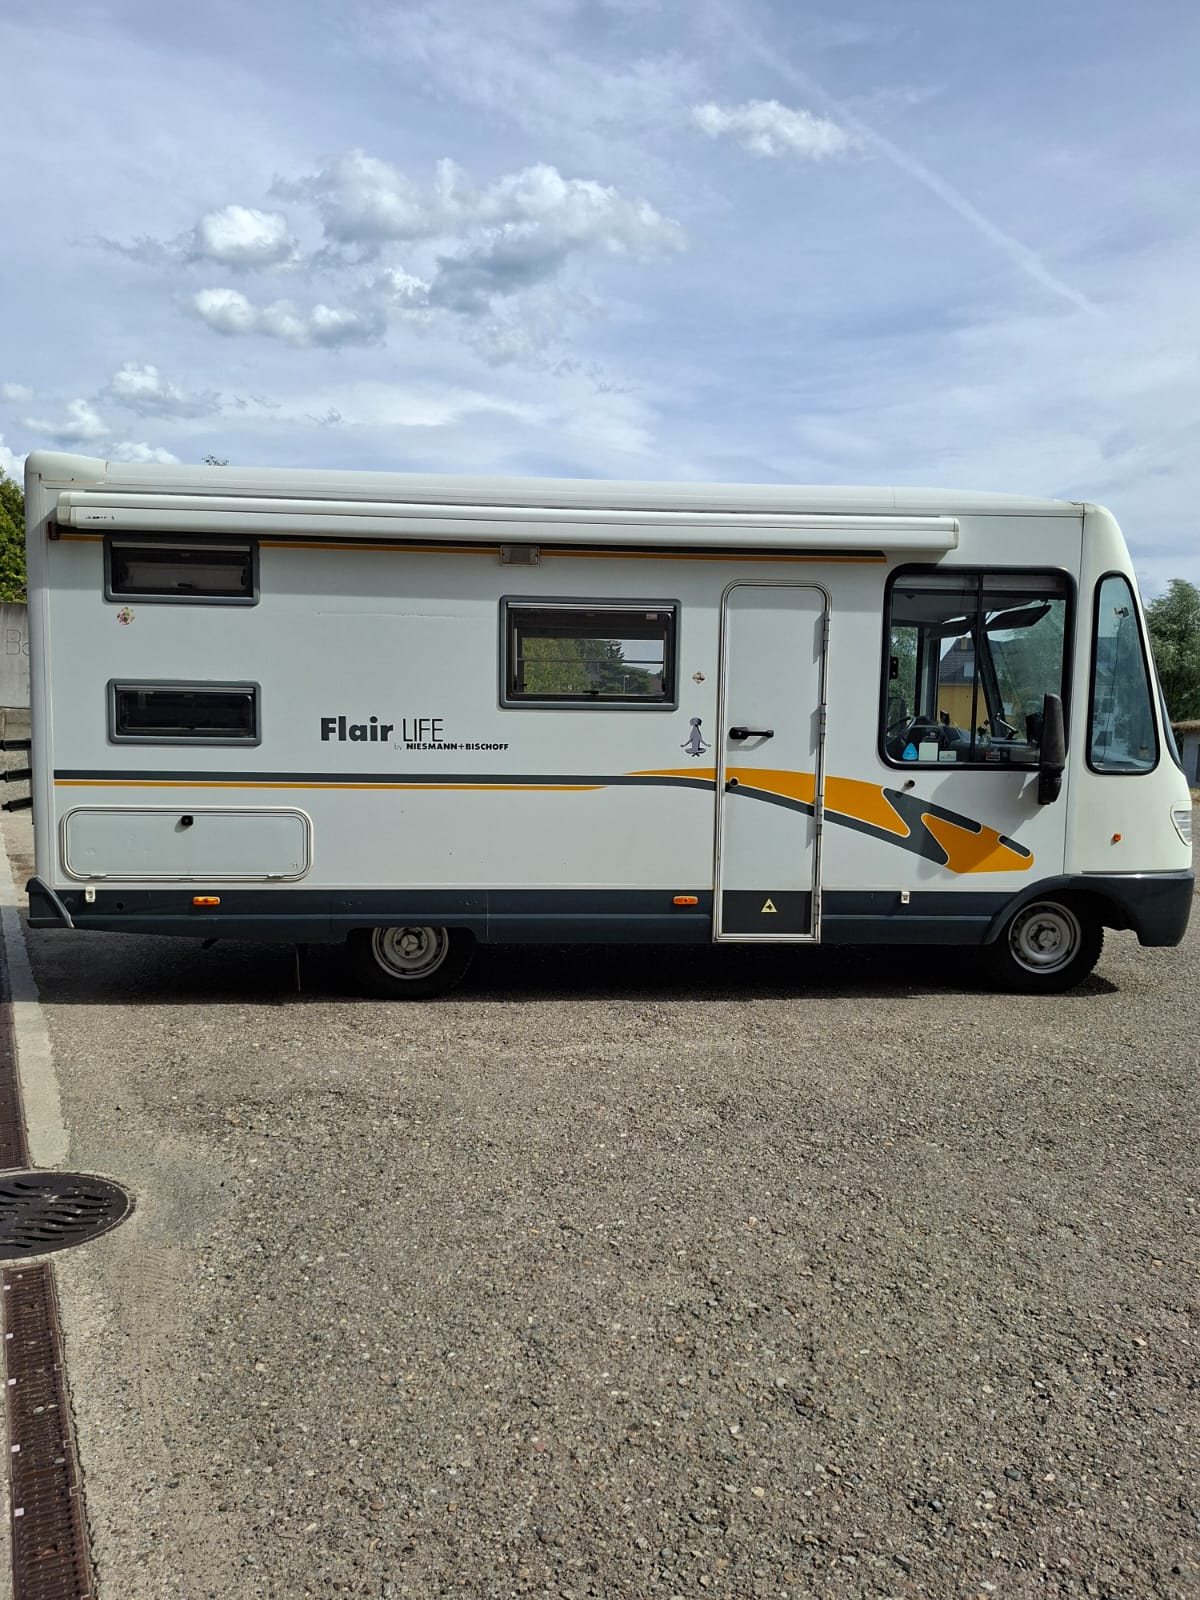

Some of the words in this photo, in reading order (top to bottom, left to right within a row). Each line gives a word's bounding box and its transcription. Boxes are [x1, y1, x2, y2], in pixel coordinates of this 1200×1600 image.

[320, 715, 394, 742] Flair
[402, 718, 444, 742] LIFE
[406, 742, 509, 751] NIESMANN+BISCHOFF
